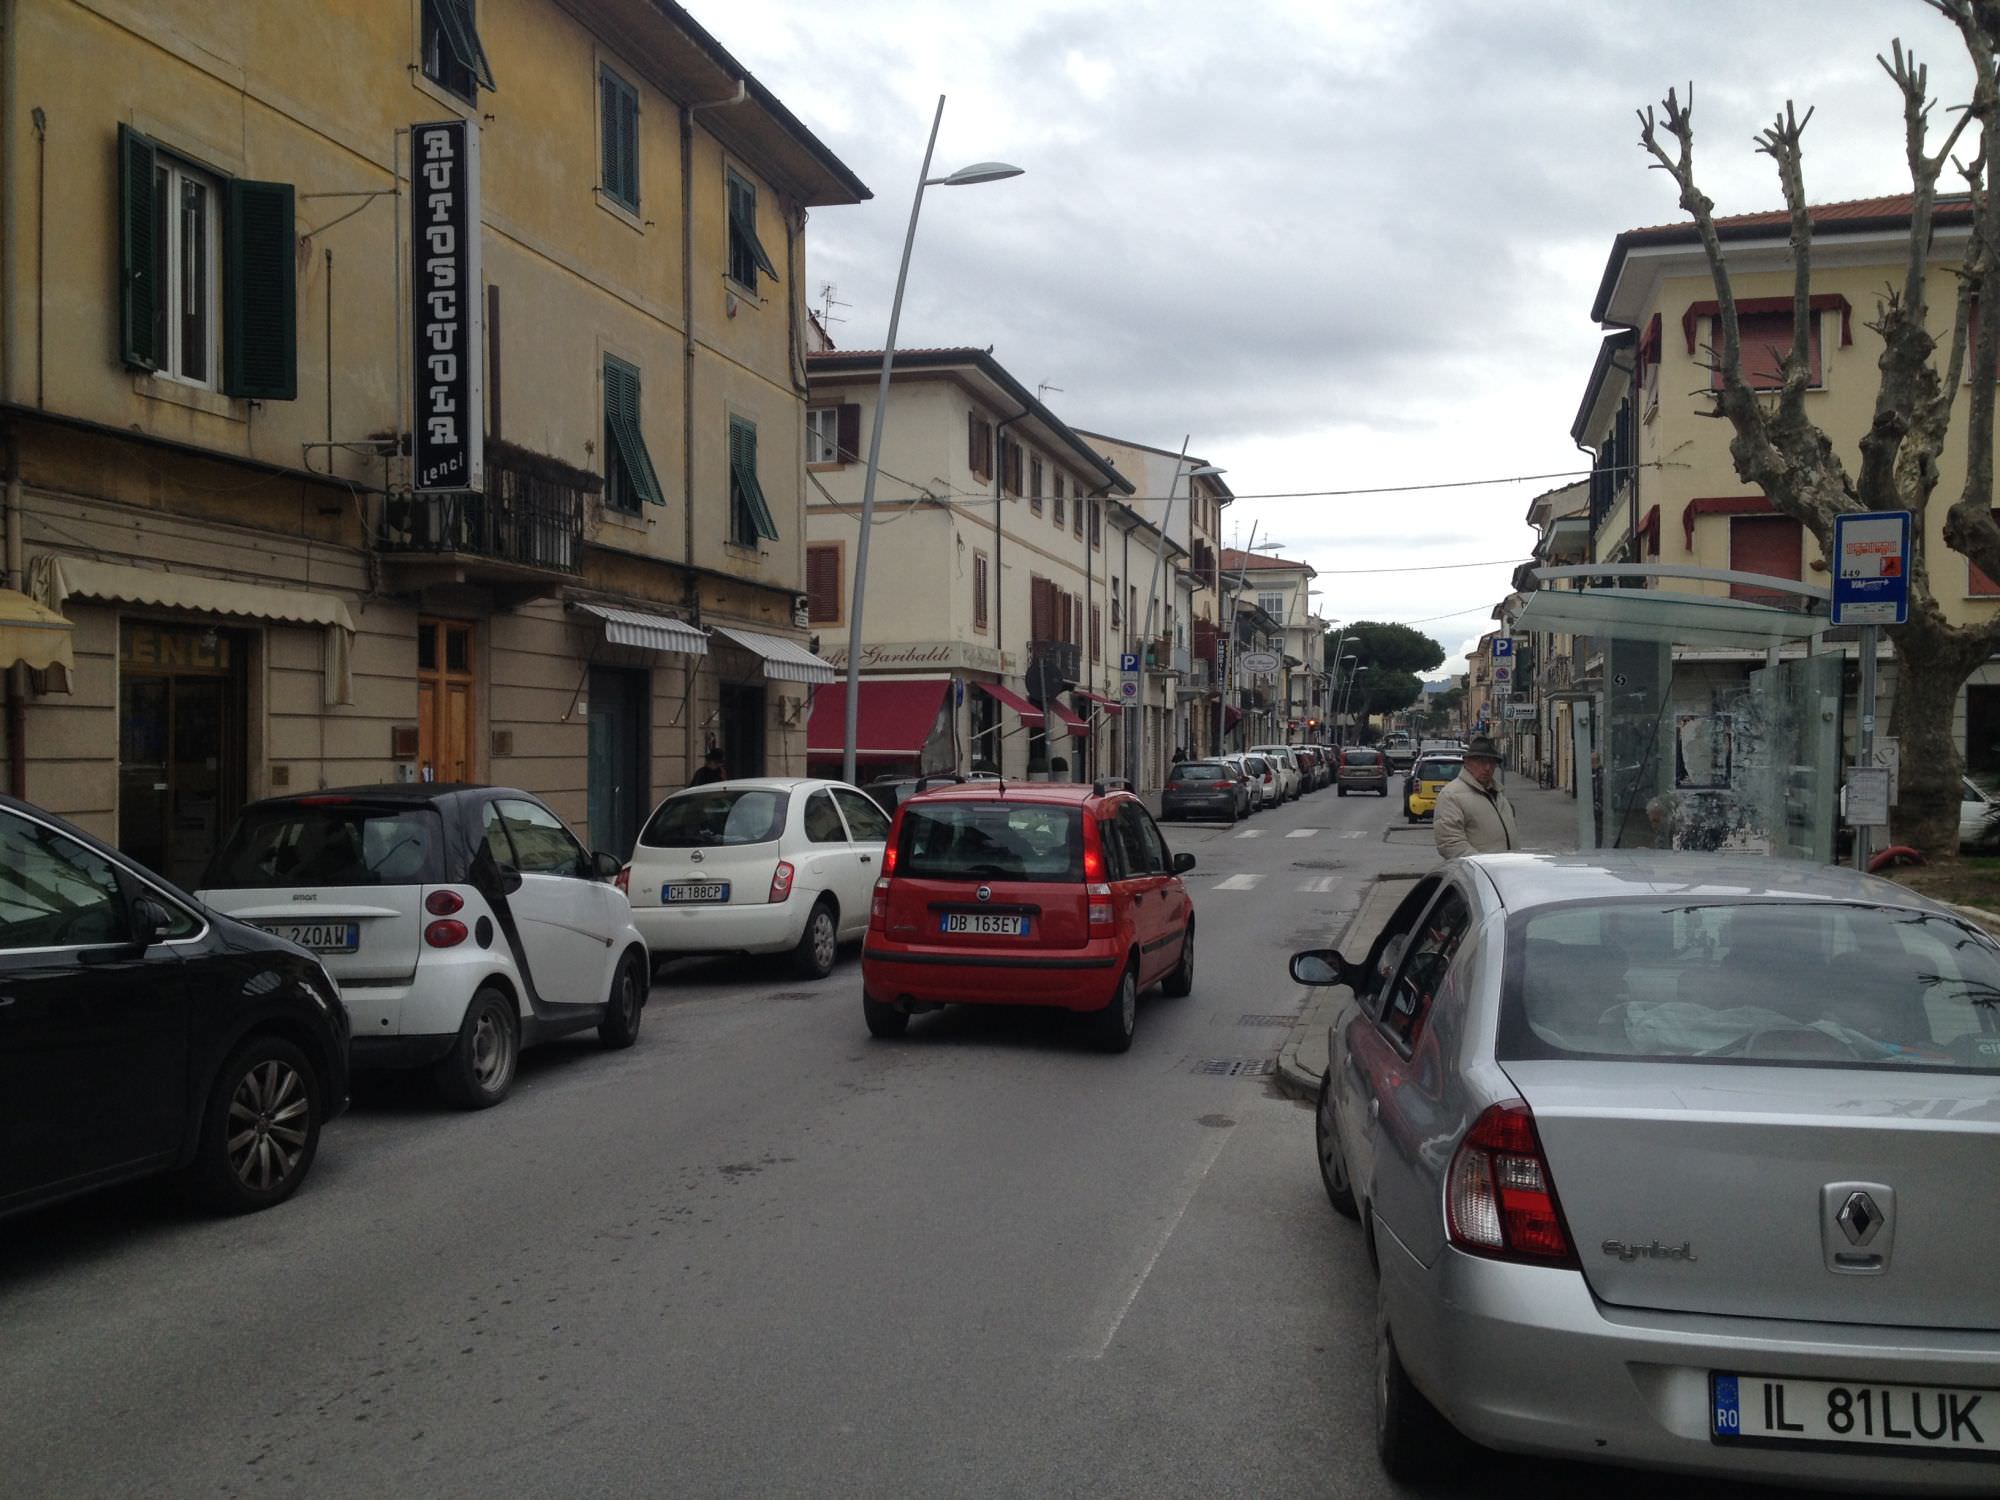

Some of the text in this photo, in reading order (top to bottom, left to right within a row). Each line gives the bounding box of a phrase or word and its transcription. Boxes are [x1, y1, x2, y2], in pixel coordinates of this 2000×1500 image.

[423, 129, 458, 444] AUTOSCUOLA
[423, 451, 463, 485] Lenci
[858, 646, 953, 666] Garibaldi
[1496, 640, 1508, 655] P
[1124, 655, 1135, 670] P
[670, 886, 721, 899] CH 188CP
[950, 915, 1020, 933] DB 163EY
[1717, 1407, 1738, 1428] RO
[1764, 1383, 1804, 1432] IL
